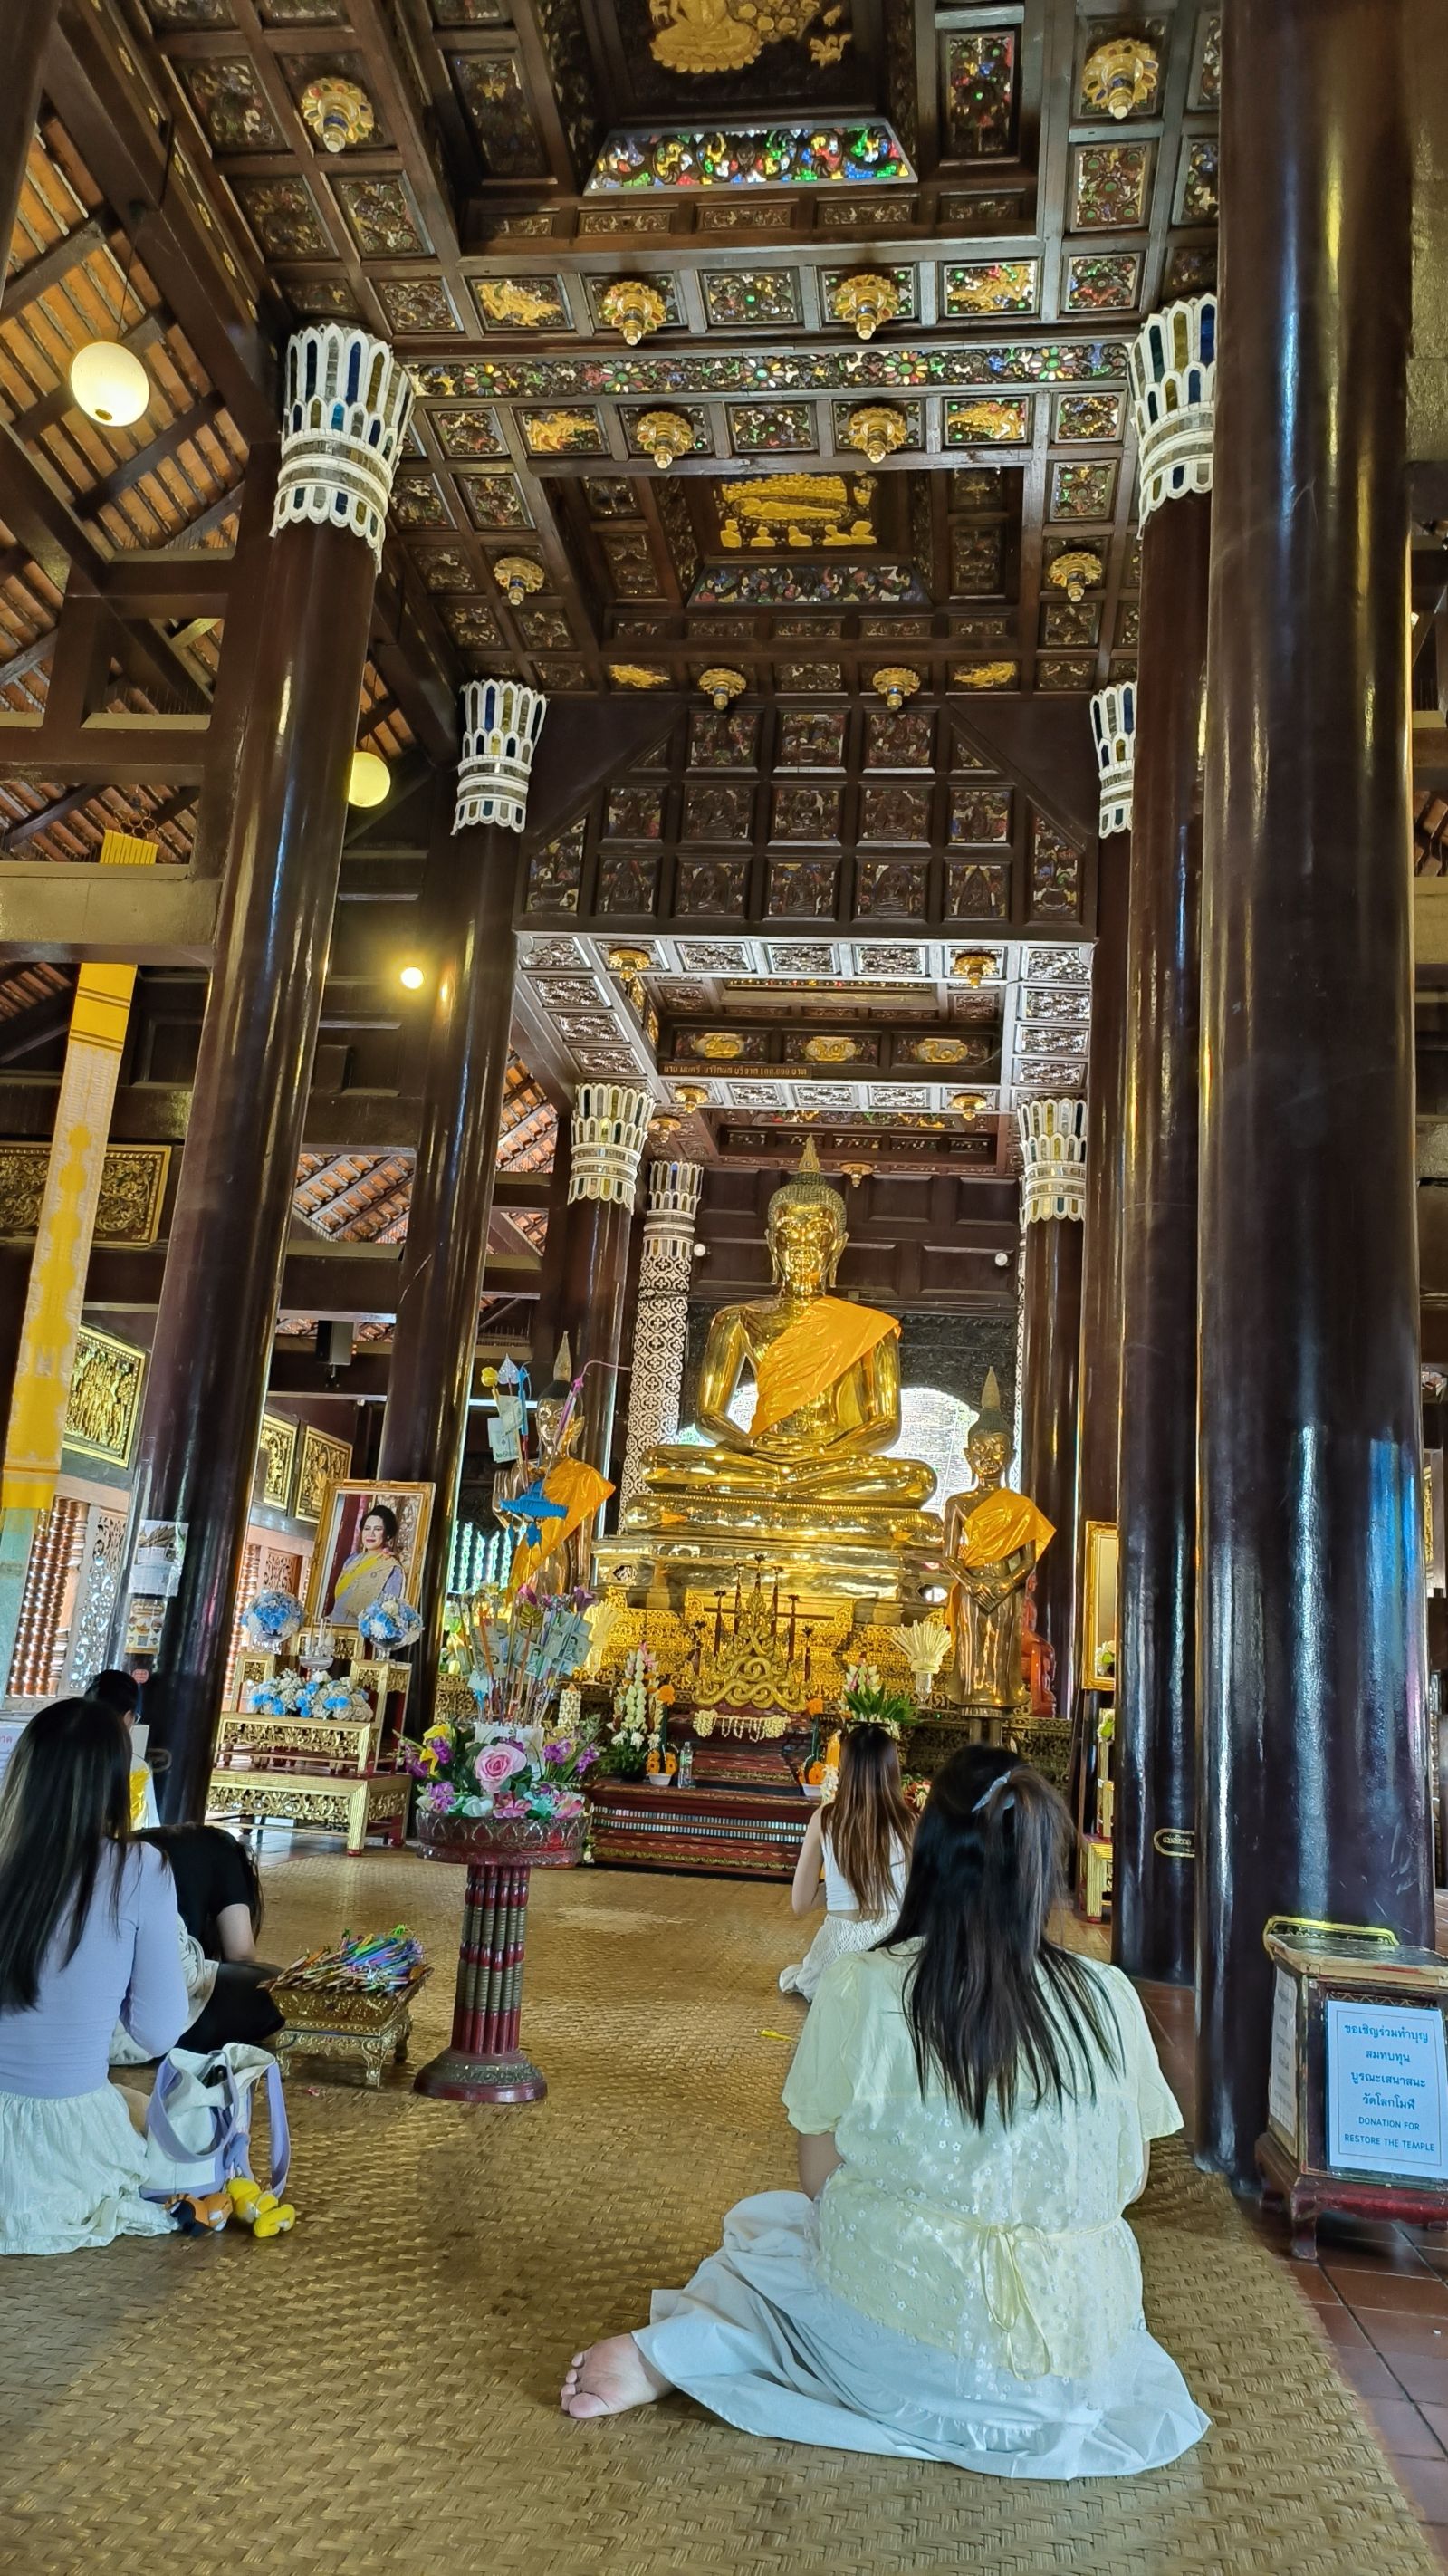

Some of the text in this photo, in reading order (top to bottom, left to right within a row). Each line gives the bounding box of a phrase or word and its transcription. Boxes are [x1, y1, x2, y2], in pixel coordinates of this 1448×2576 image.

[1344, 2023, 1429, 2043] ขอเชิญร่วมทำบุญ
[1365, 2050, 1410, 2065] สมทบทุน
[1350, 2071, 1426, 2087] บูรณะเสนาสนะ
[1362, 2092, 1415, 2110] วัดโลกโมฬี
[1358, 2116, 1420, 2130] DONATION FOR
[1344, 2133, 1435, 2152] RESTORE THE TEMPLE
